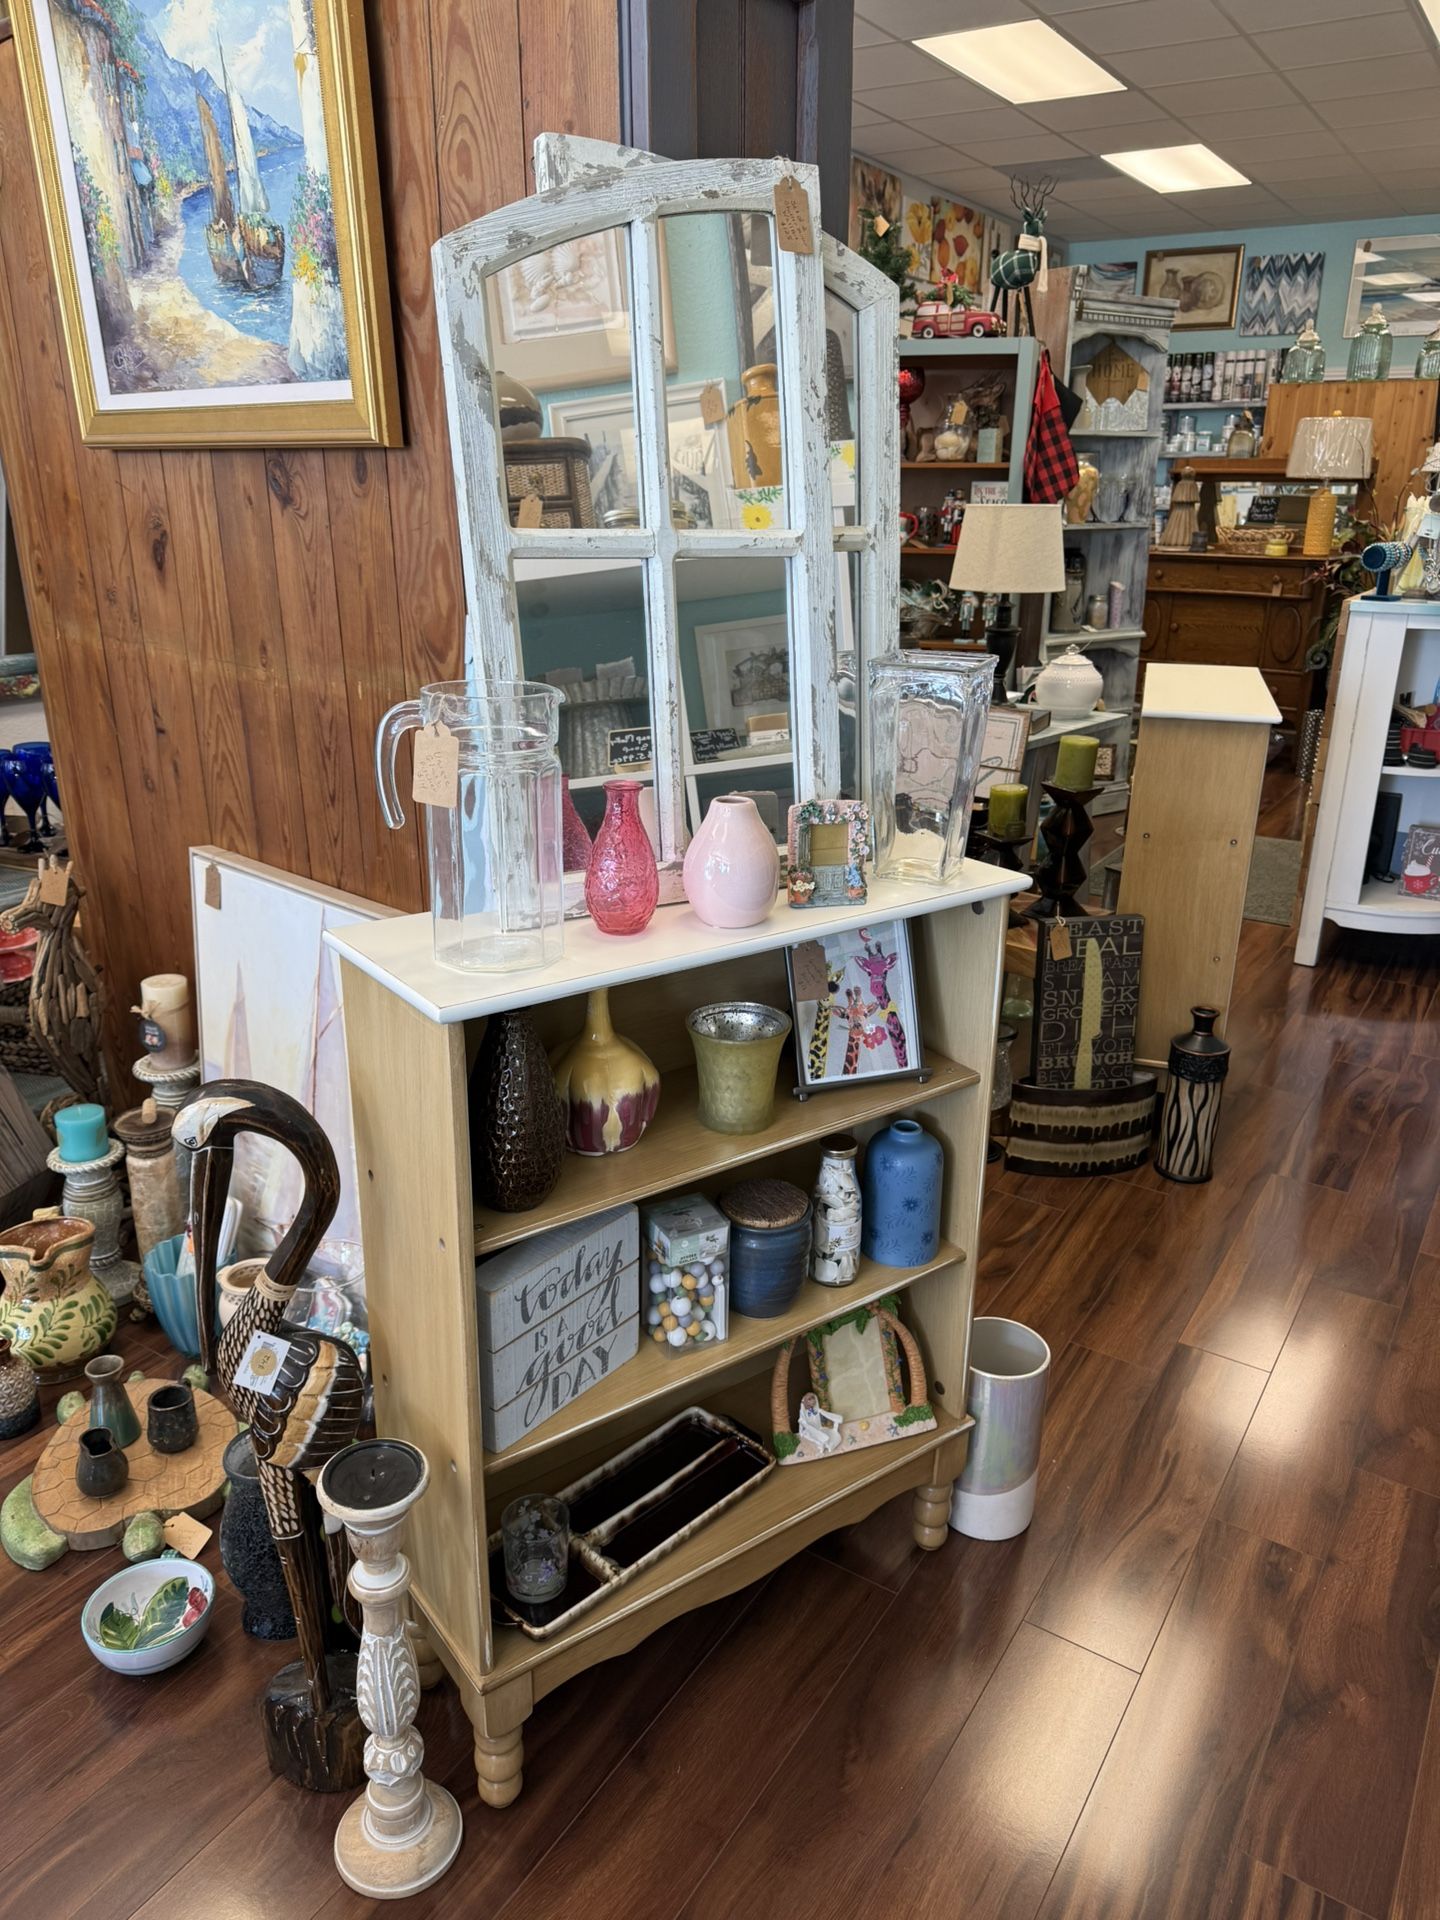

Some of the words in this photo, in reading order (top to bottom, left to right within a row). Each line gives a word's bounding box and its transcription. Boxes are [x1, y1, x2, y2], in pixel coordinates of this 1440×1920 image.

[1044, 970, 1140, 991] STAM
[1041, 1003, 1137, 1020] GROERY
[1043, 986, 1138, 1008] SNCK
[1040, 1016, 1136, 1042] DIH
[514, 1240, 623, 1320] today
[534, 1327, 549, 1352] IS
[557, 1316, 568, 1338] A
[515, 1276, 623, 1428] good
[552, 1334, 618, 1411] DAY
